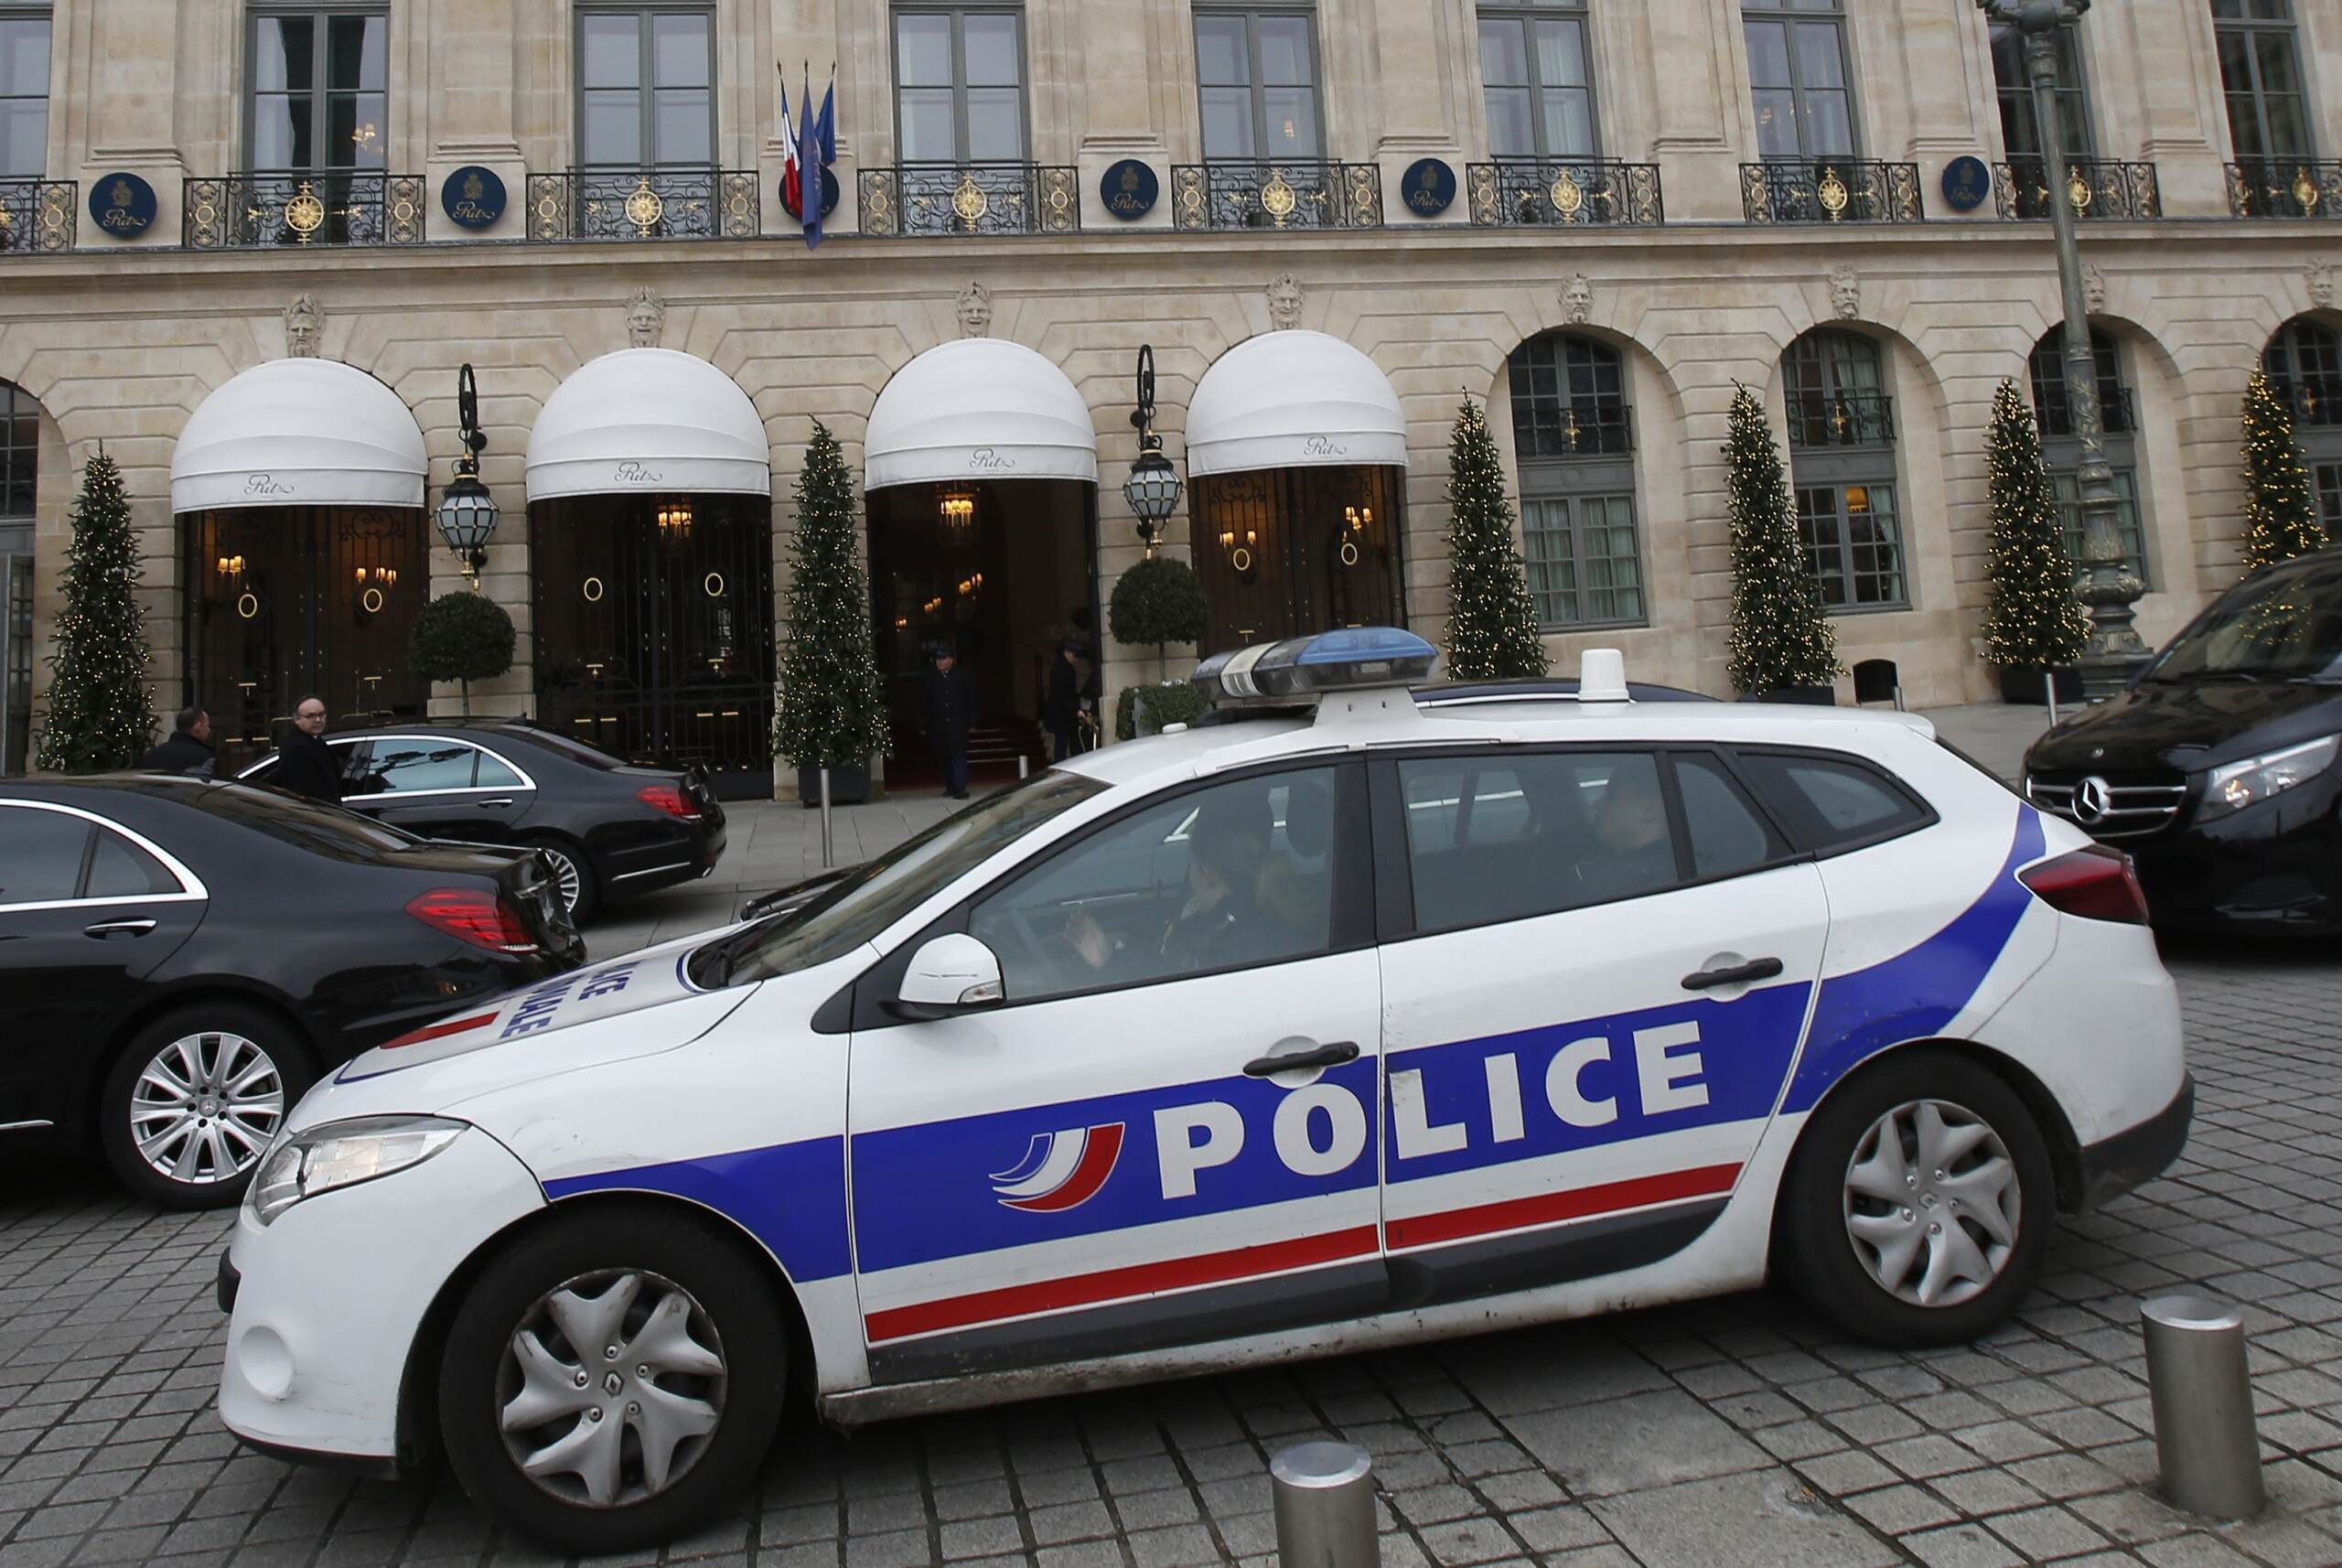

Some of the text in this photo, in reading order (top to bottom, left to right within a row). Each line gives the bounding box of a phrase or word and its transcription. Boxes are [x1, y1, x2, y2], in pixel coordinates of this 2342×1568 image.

[1112, 192, 1149, 209] Ritz
[1410, 189, 1446, 208] Ritz
[102, 209, 146, 227] Ritz
[453, 201, 496, 219] Ritz
[1303, 435, 1348, 455] Ritz
[969, 448, 1015, 468] Ritz
[615, 461, 662, 482] Ritz
[243, 474, 295, 495] Ritz
[1152, 1020, 1710, 1200] POLICE
